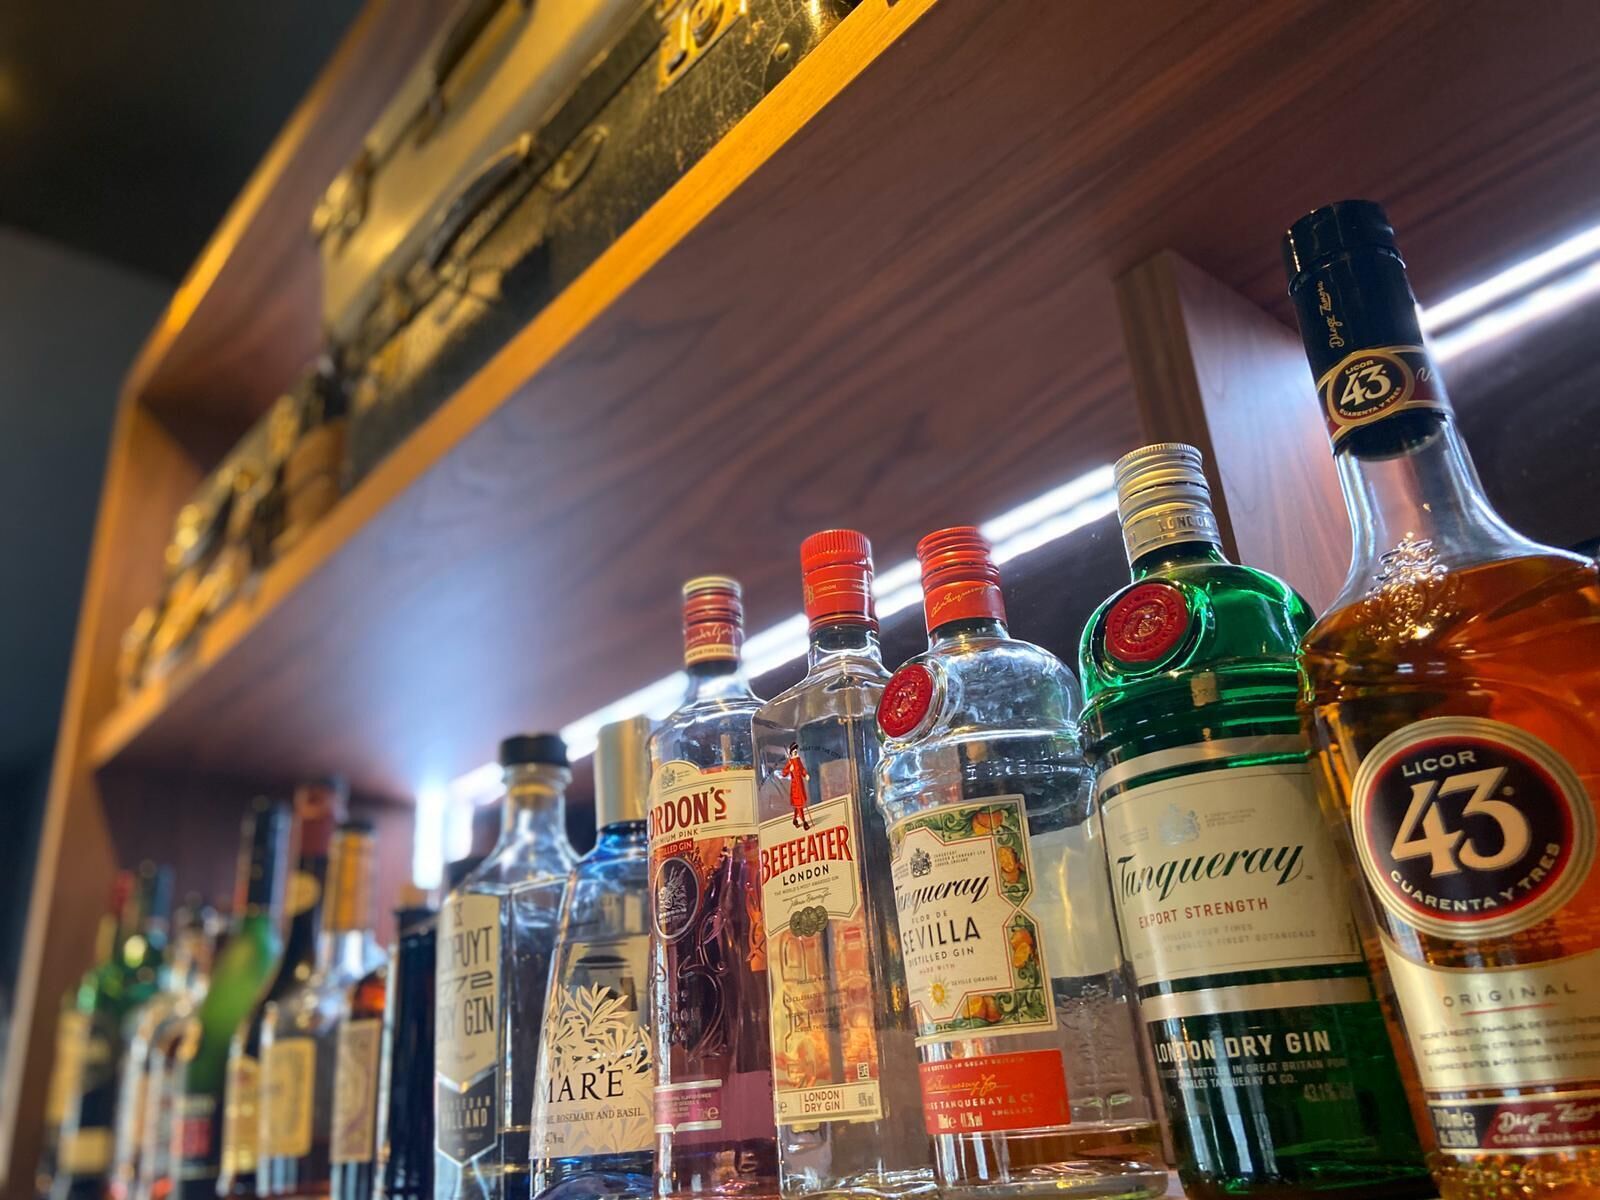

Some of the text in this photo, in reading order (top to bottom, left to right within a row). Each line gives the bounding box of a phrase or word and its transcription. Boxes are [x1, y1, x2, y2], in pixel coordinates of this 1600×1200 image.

[1345, 360, 1374, 375] LICOR
[1340, 364, 1391, 406] 43
[1402, 750, 1478, 777] LICOR
[650, 787, 727, 841] ORDON'S
[1390, 766, 1532, 879] 43
[678, 828, 699, 838] PINK
[679, 841, 692, 852] GIN
[760, 824, 854, 887] BEEFEATER
[782, 863, 829, 886] LONDON
[1117, 845, 1305, 906] Tanqueray
[1390, 842, 1561, 912] CUARENTA Y TRES
[935, 909, 948, 919] DE
[1138, 896, 1269, 930] EXPORT STRENGTH
[902, 916, 982, 956] SEVILLA
[952, 946, 975, 958] GIN
[1442, 982, 1577, 1008] ORIGINAL
[463, 994, 494, 1036] GIN
[1155, 1029, 1333, 1064] LONDON DRY GIN
[1232, 1064, 1243, 1074] IN
[1246, 1061, 1279, 1073] GREAT
[1281, 1058, 1325, 1072] BRITAIN
[804, 1090, 840, 1103] LONDON
[804, 1100, 841, 1113] DRY GIN
[940, 1096, 1003, 1110] TANQUERAY
[596, 1109, 616, 1121] AND
